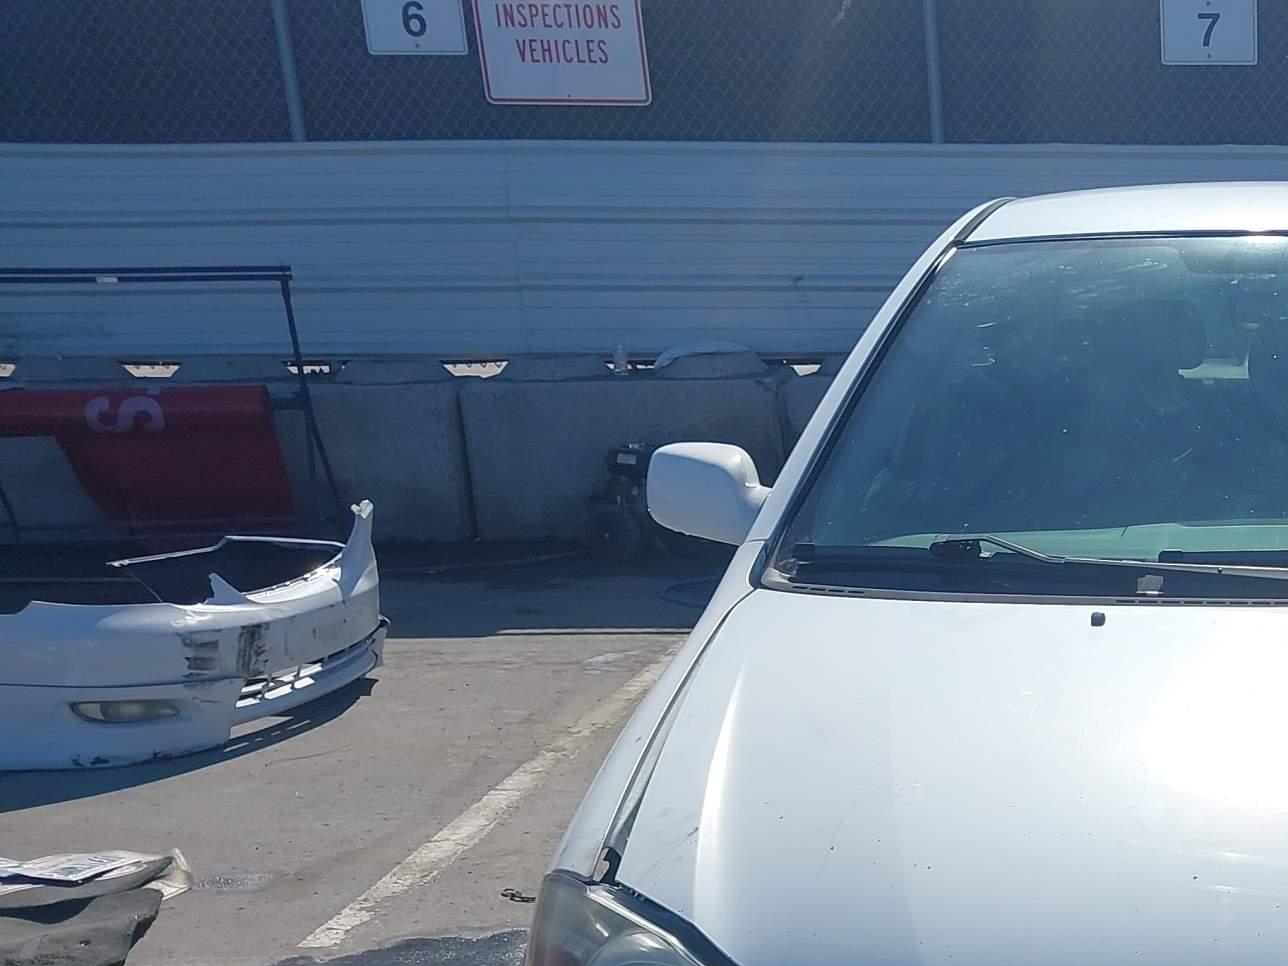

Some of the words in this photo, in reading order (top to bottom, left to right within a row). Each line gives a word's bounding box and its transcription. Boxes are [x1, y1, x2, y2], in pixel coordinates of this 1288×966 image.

[402, 1, 427, 37] 6
[495, 3, 622, 29] INSPECTIONS
[1198, 12, 1220, 47] 7
[515, 38, 609, 64] VEHICLES
